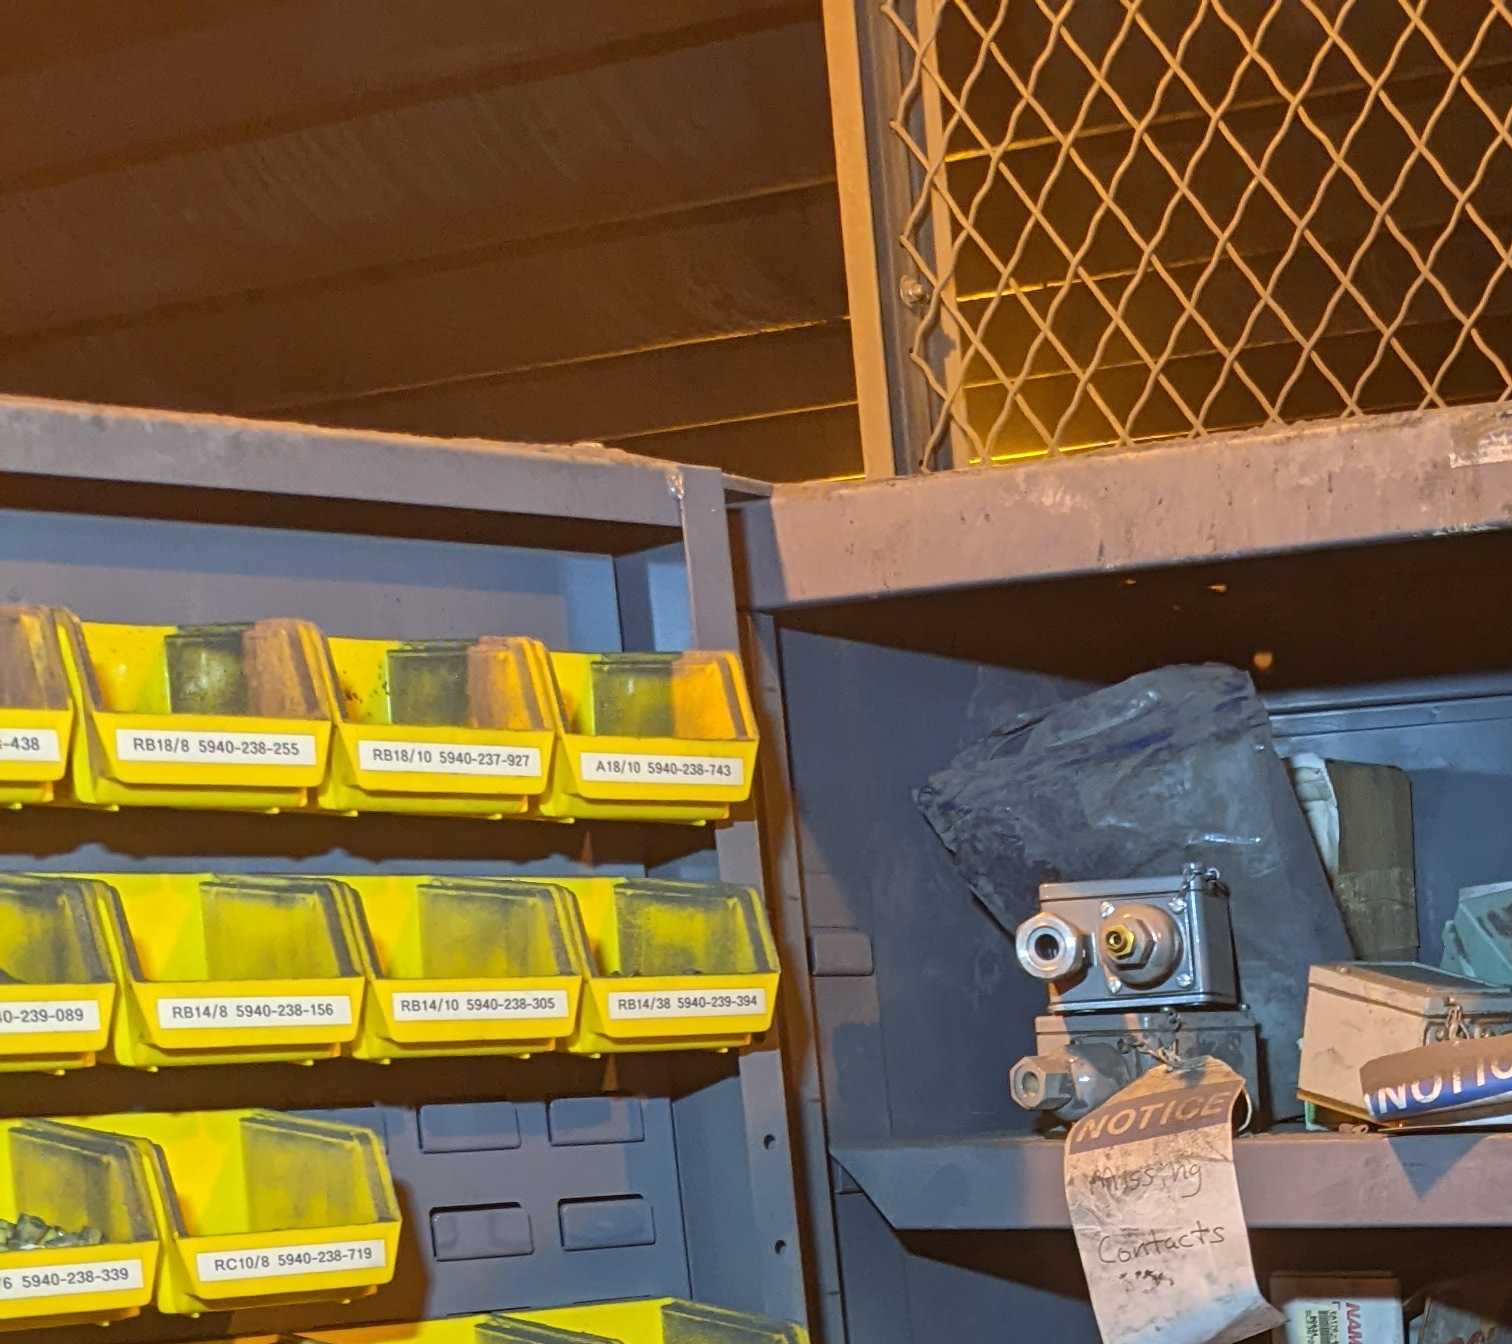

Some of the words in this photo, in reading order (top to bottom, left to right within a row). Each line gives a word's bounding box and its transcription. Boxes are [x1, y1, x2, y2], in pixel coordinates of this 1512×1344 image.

[0, 736, 40, 752] -438
[132, 736, 191, 754] RB18/8
[199, 740, 301, 757] 5940-238-255
[372, 748, 432, 765] RB18/10
[439, 751, 531, 769] 5940-237-927
[595, 759, 642, 775] A18/10
[647, 761, 732, 778] 5940-238-743
[172, 1004, 228, 1020] RB14/8
[235, 1002, 334, 1018] 5940-238-156
[401, 998, 459, 1012] RB14/10
[466, 996, 556, 1011] 5940-238-305
[617, 997, 671, 1011] RB14/38
[677, 994, 758, 1009] 5940-239-394
[1074, 1091, 1234, 1143] NOTICE
[1098, 1220, 1227, 1265] Contacts
[214, 1254, 270, 1271] RC10/8
[278, 1247, 373, 1267] 5940-238-719
[22, 1267, 129, 1290] 5940-238-339
